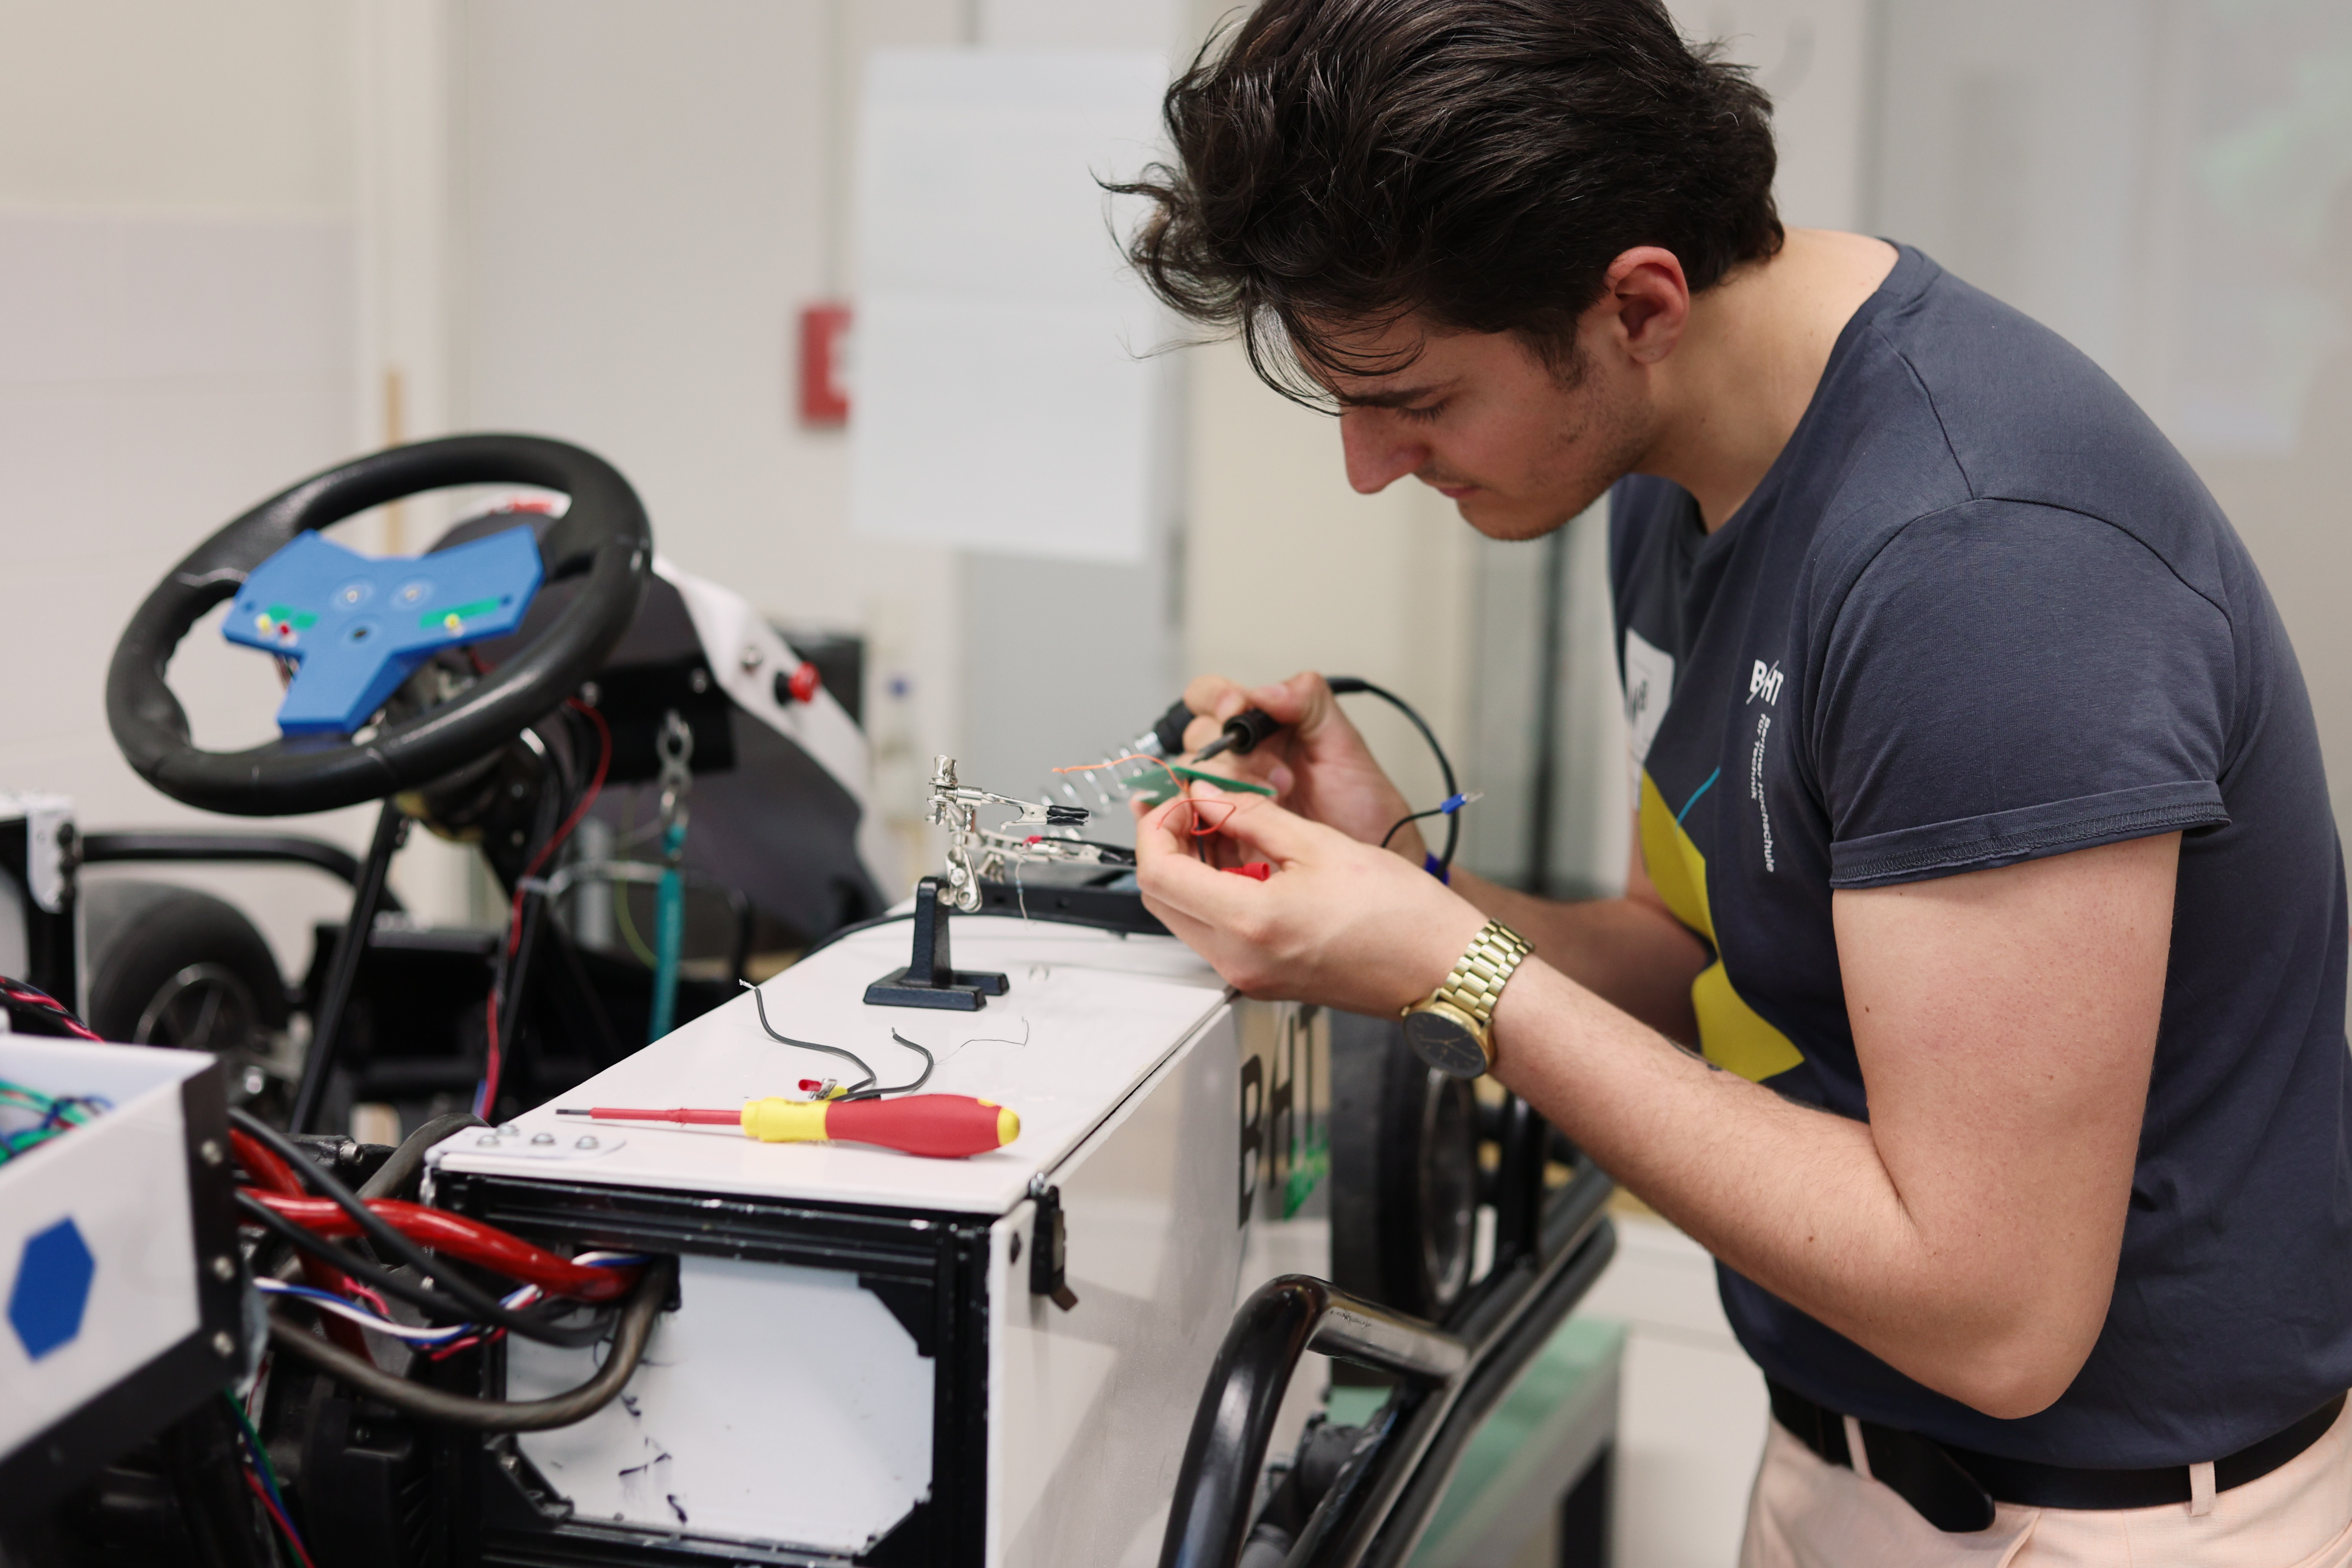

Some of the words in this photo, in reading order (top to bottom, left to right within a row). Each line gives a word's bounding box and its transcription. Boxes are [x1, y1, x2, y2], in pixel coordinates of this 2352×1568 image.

[1751, 740, 1761, 800] Technik
[1757, 717, 1771, 780] Berliner
[1757, 782, 1775, 873] Hochschule
